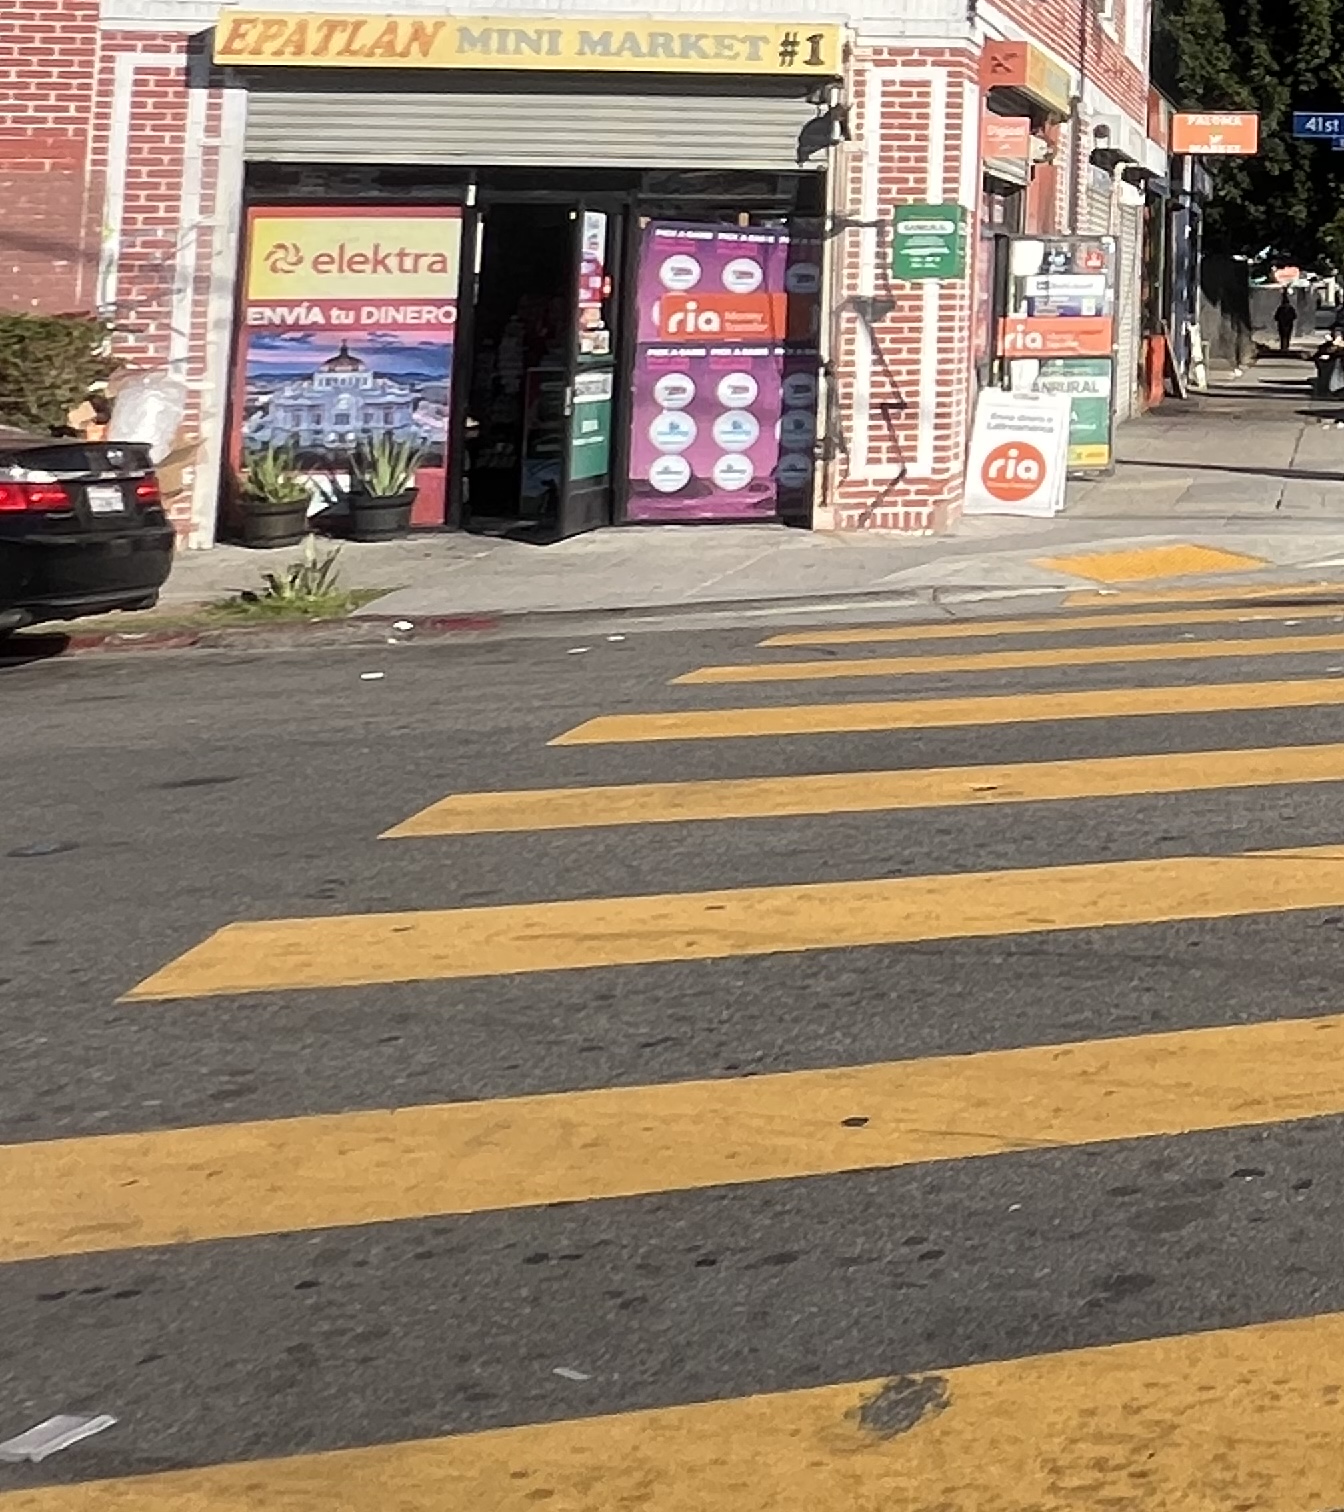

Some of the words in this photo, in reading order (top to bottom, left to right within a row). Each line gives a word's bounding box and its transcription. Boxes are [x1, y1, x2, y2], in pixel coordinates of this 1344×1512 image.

[217, 18, 446, 57] EPATLAN
[455, 26, 562, 55] MINI
[575, 30, 769, 61] MARKET
[778, 31, 825, 67] #1
[1305, 117, 1338, 132] 41st
[311, 242, 448, 274] elektra
[246, 301, 325, 326] ENVÍA
[330, 307, 355, 324] tu
[360, 306, 458, 324] DINERO
[667, 300, 721, 334] ria
[1004, 324, 1043, 350] ria
[1030, 380, 1099, 393] ANRURAL
[988, 448, 1039, 480] ria
